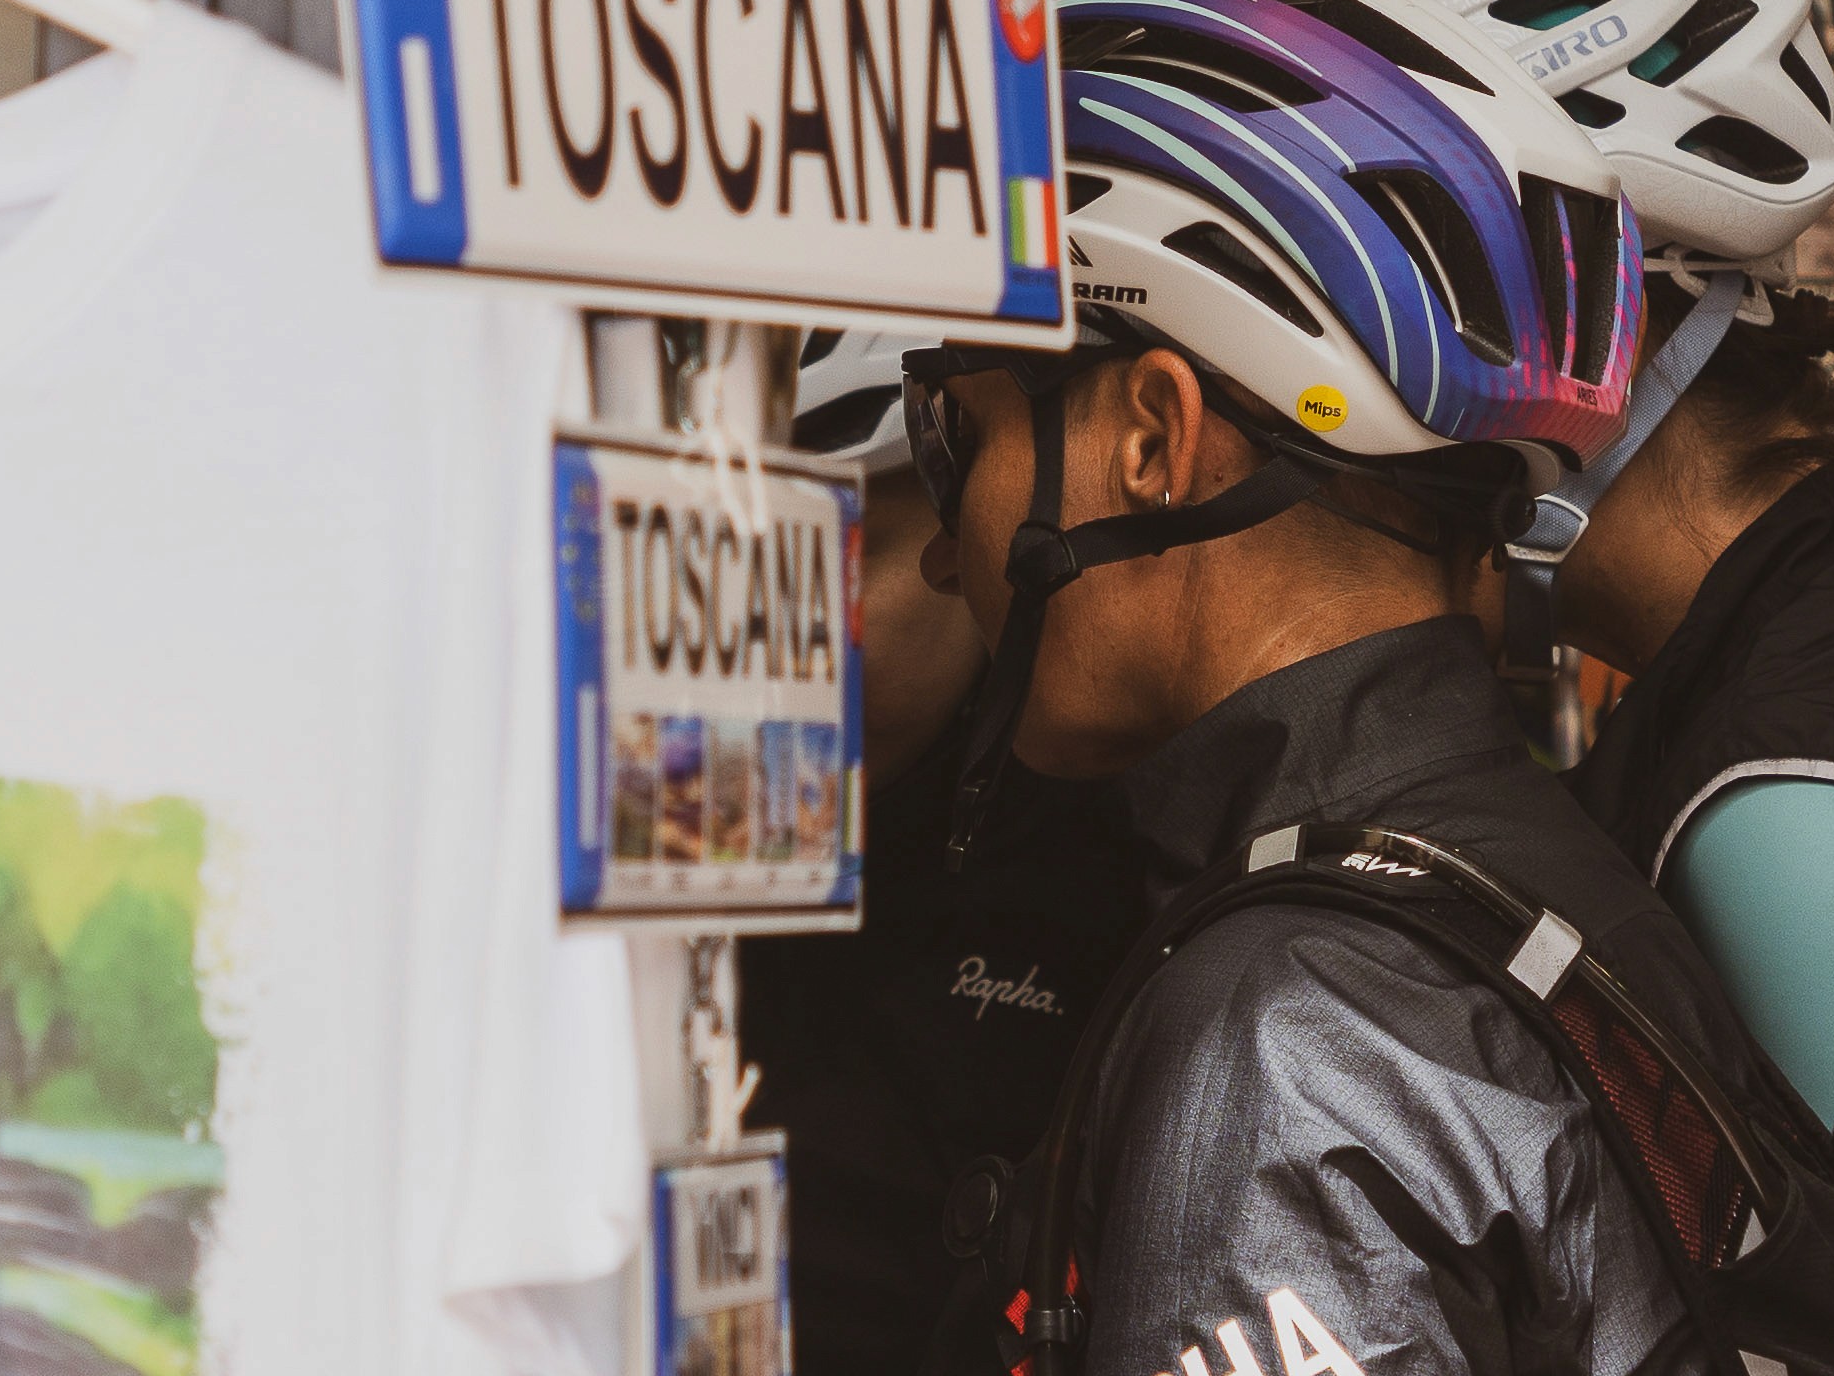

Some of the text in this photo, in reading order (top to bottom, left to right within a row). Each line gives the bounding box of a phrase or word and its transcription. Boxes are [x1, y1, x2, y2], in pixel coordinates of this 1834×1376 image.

[1072, 282, 1148, 305] RAM
[1576, 386, 1598, 407] ARIES
[1304, 399, 1342, 418] Mips
[613, 498, 836, 683] TOSCANA
